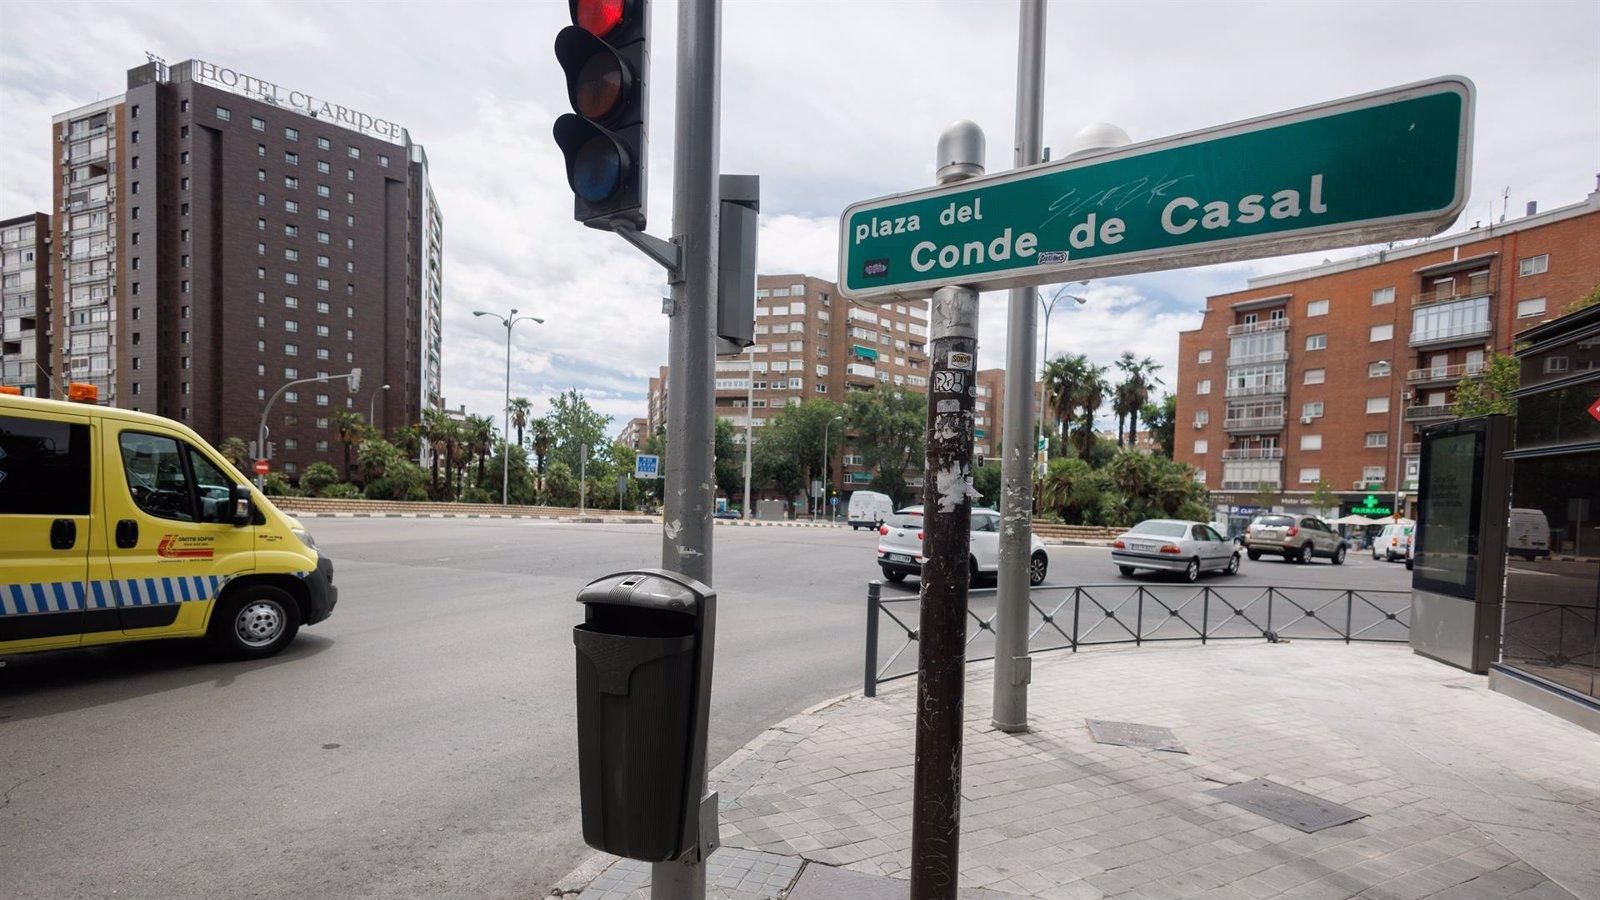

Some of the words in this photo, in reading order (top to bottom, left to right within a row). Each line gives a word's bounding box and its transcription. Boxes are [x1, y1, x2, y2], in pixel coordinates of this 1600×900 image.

[200, 60, 284, 102] HOTEL
[289, 91, 401, 139] CLARIDGE
[856, 215, 921, 245] plaza
[940, 197, 983, 226] del
[910, 226, 1038, 273] Conde
[1069, 212, 1126, 249] de
[1161, 173, 1327, 235] Casal
